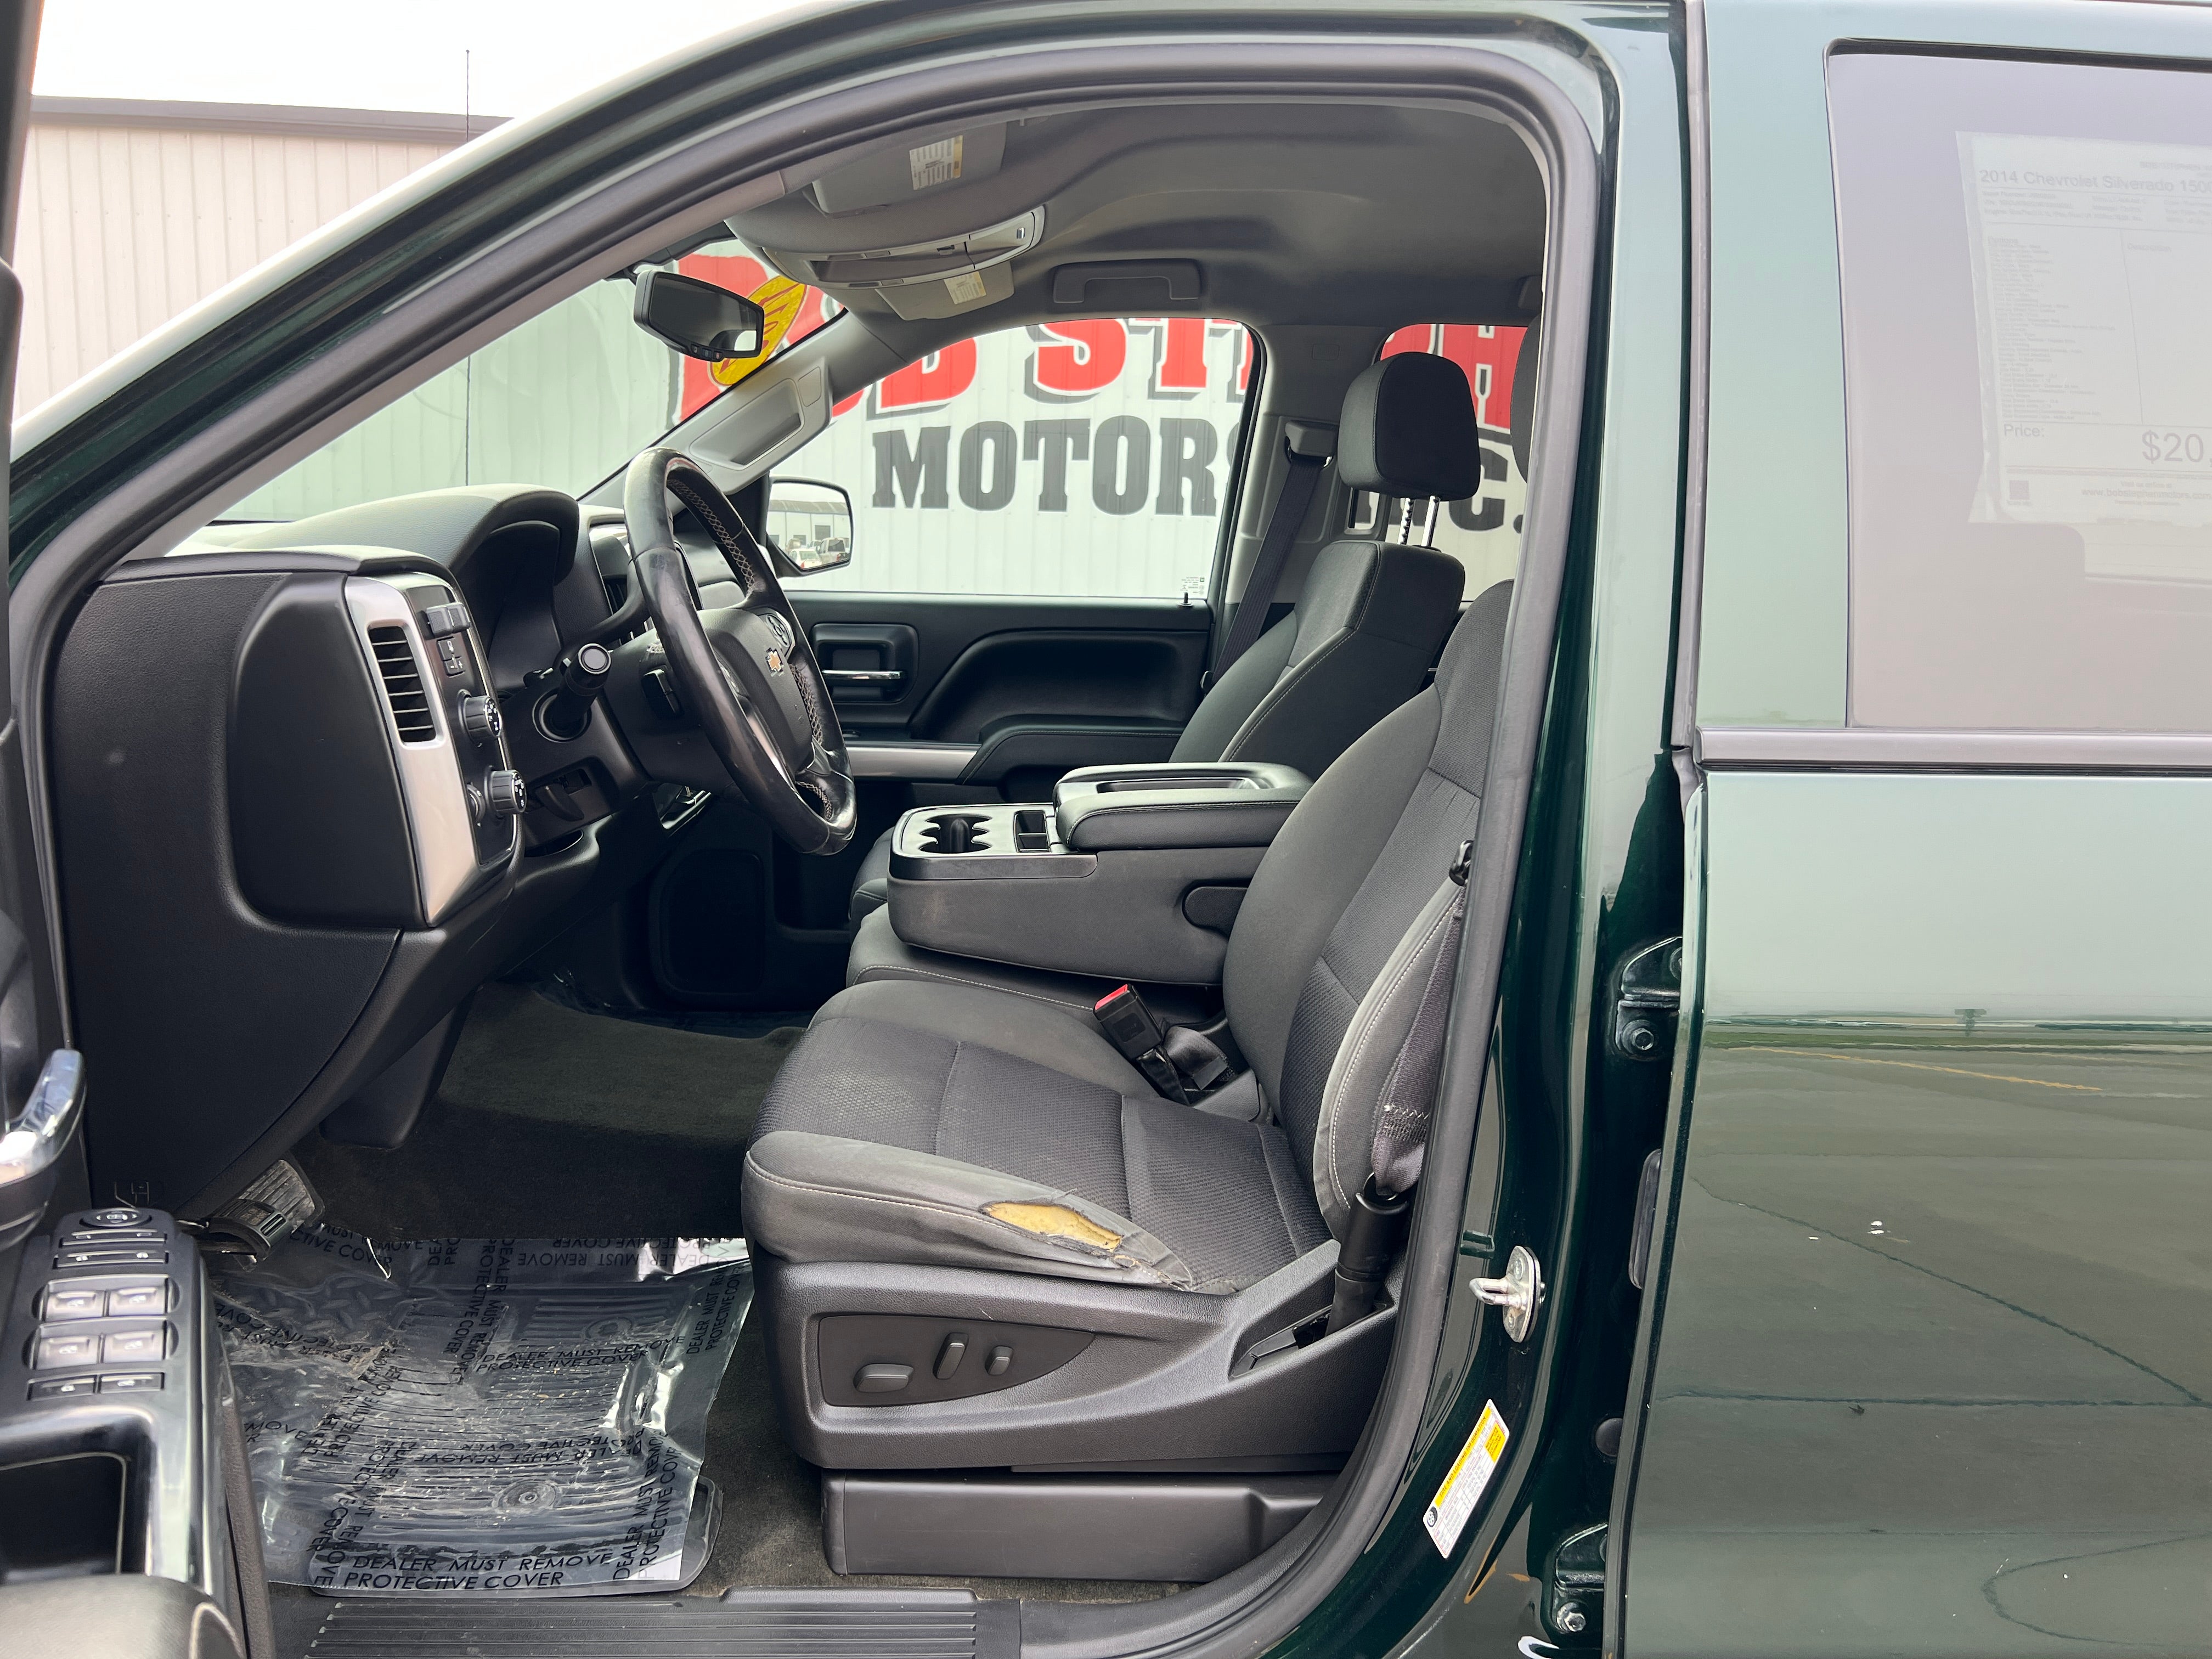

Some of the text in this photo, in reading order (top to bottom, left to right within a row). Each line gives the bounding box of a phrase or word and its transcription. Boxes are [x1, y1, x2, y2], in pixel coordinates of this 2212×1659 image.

[1979, 170, 2019, 184] 2014
[2023, 171, 2098, 188] Chevrolet
[2102, 174, 2175, 192] Silverado
[2003, 424, 2045, 438] Price:
[872, 415, 1239, 516] MOTOR
[518, 1253, 585, 1266] REMOVE
[598, 1253, 640, 1266] MUST
[686, 1319, 710, 1354] DEALER
[702, 1293, 719, 1315] MUST
[706, 1296, 735, 1350] PROTECTIVE
[443, 1320, 474, 1353] COVER
[476, 1350, 649, 1372] PROTECTIVE COVER
[482, 1352, 548, 1363] DEALER
[558, 1348, 600, 1358] MUST
[613, 1525, 645, 1581] DEALER
[633, 1481, 655, 1517] MUST
[353, 1553, 613, 1572] DEALER MUST REMOVE
[344, 1571, 564, 1590] PROTECTIVE COVER
